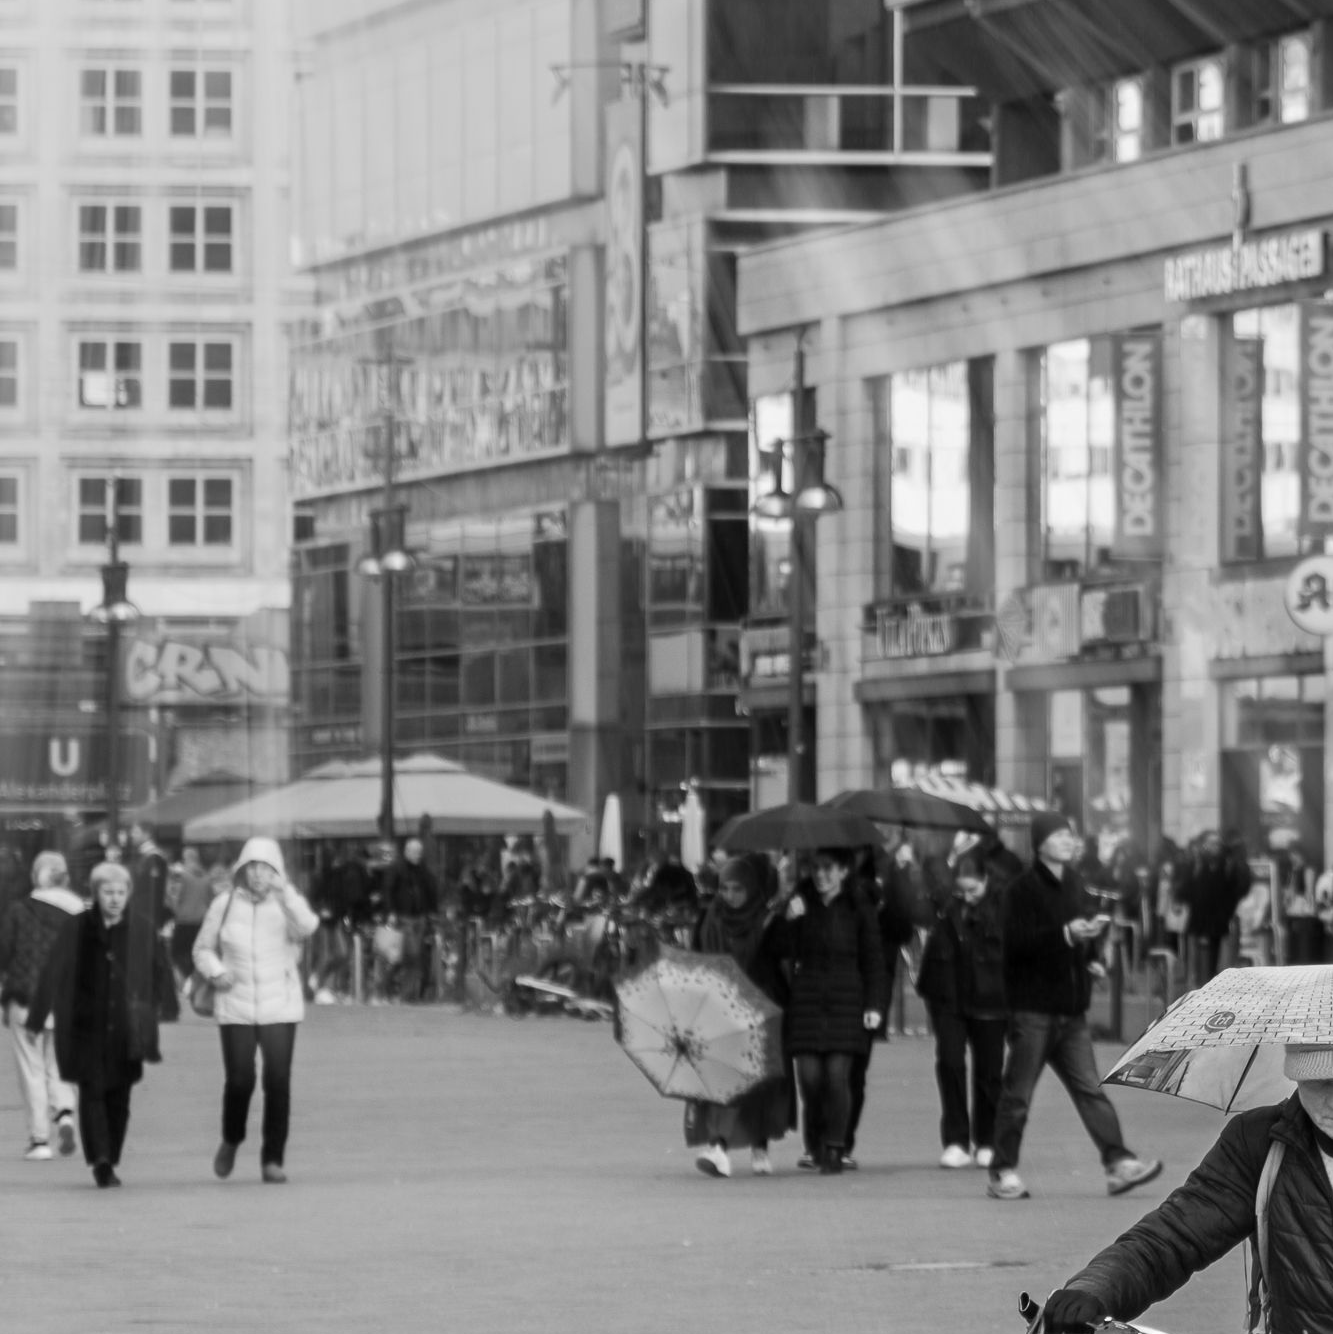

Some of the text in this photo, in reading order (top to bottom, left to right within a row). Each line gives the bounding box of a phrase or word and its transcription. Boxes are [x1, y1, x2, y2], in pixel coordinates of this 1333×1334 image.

[1122, 341, 1154, 535] DECATHLON
[49, 737, 80, 777] U
[0, 779, 133, 803] Alexanderpltz
